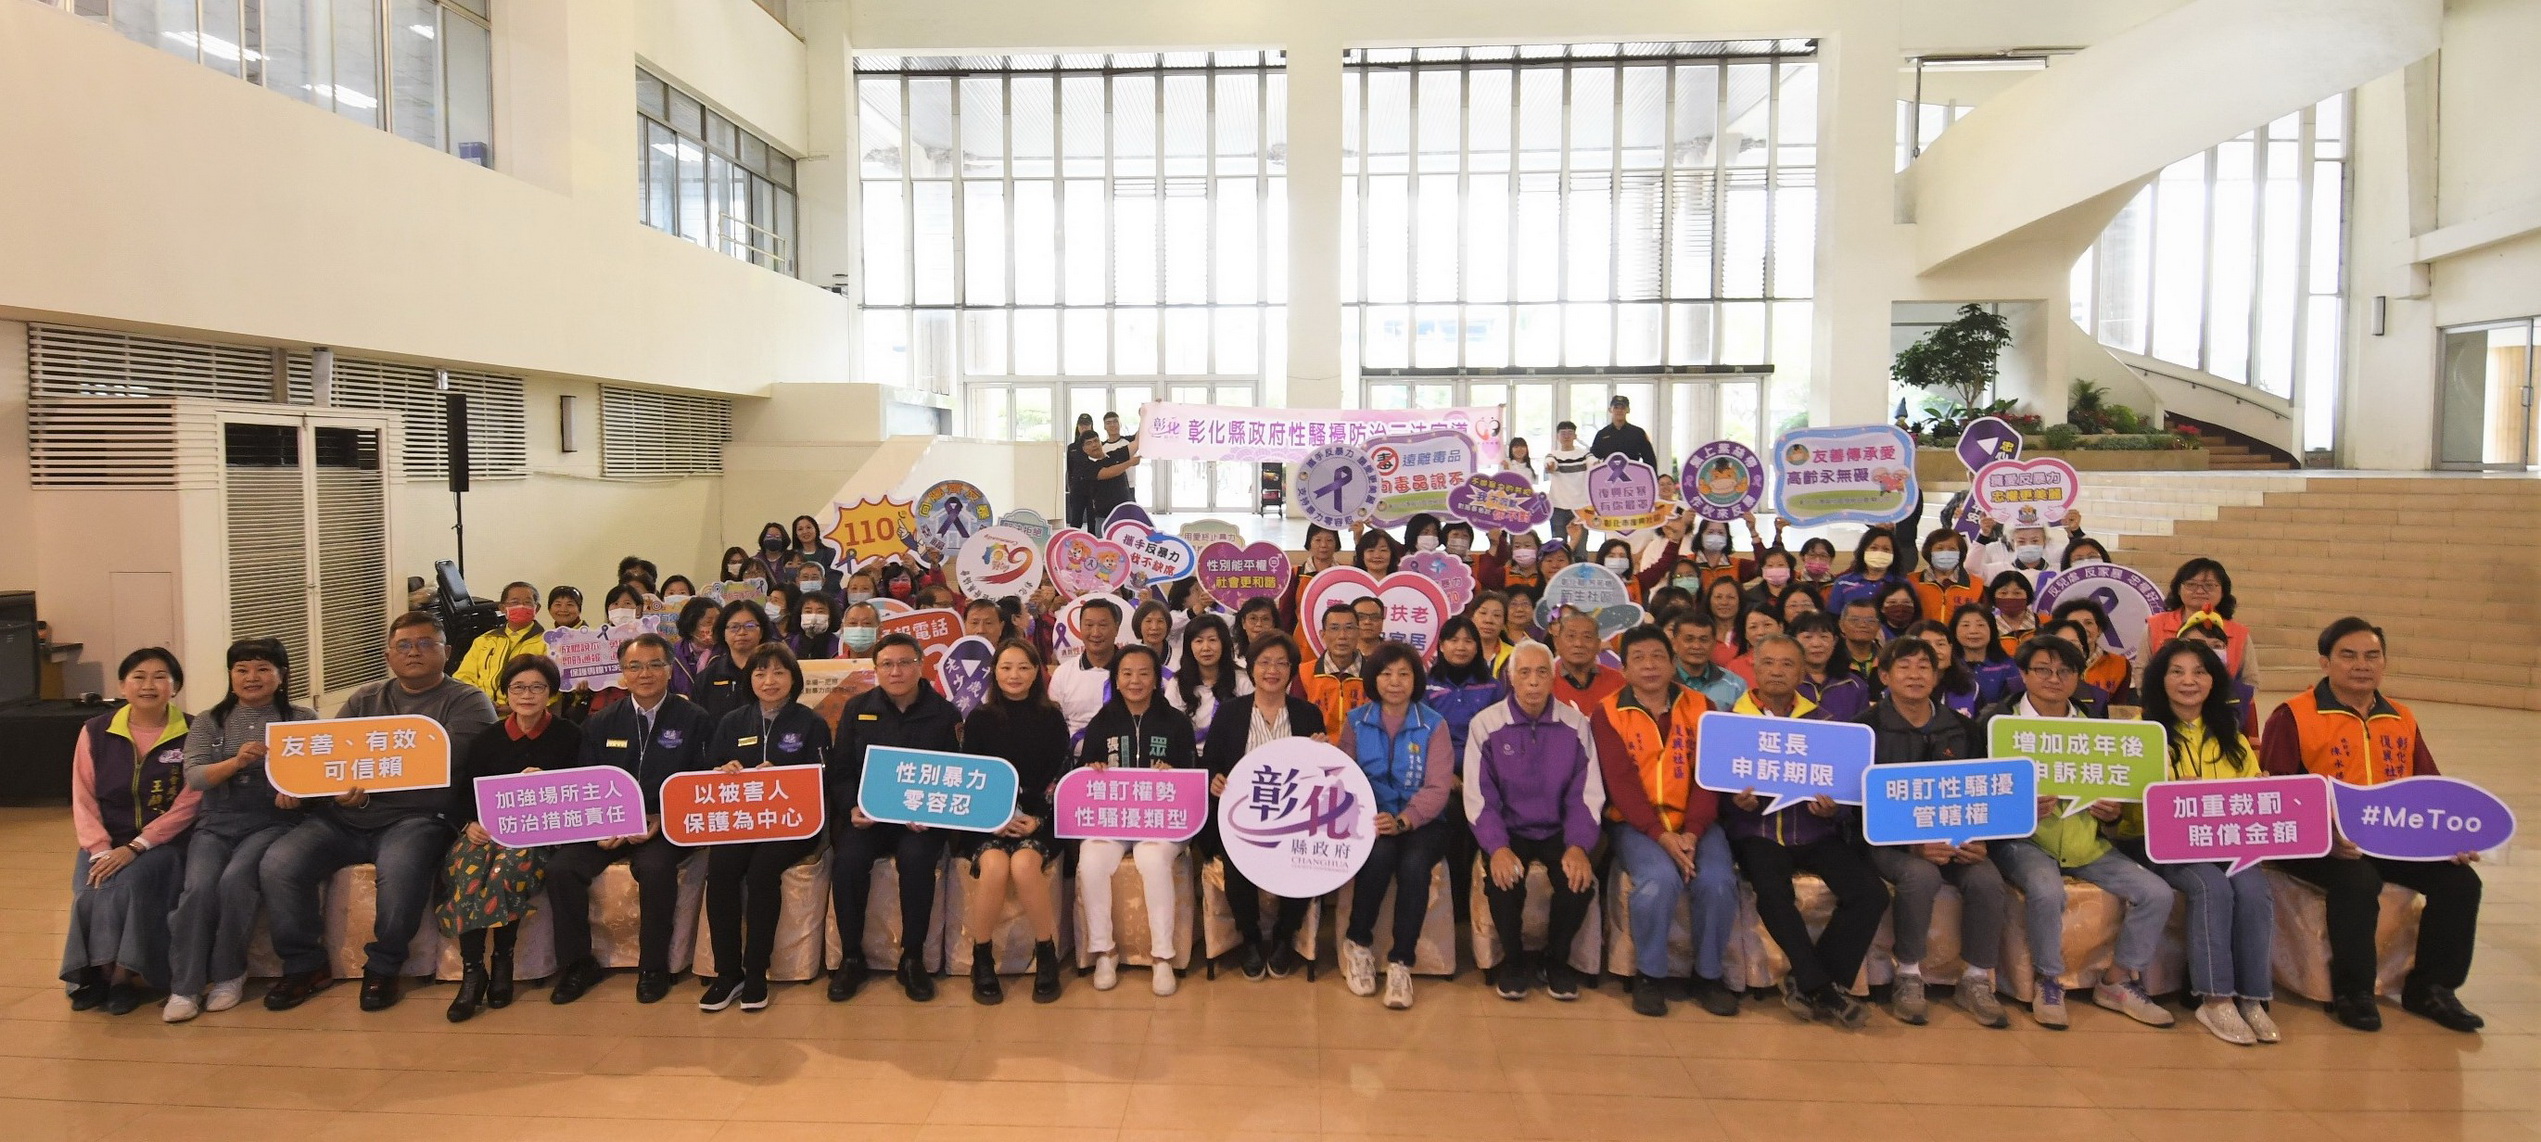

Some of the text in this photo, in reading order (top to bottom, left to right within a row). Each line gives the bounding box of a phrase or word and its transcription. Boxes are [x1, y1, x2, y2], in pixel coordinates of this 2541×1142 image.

[1402, 450, 1461, 467] 遠離毒品
[1812, 445, 1896, 463] 友善傳承愛
[845, 517, 895, 547] 110
[1185, 532, 1236, 541] 用愛終止暴力
[1122, 533, 1181, 563] 攜手反暴力
[1206, 559, 1268, 572] 性別能平權
[2085, 567, 2122, 578] 反家暴
[1215, 576, 1277, 589] 社會更和諧
[281, 728, 437, 758] 友善、有效、
[1758, 731, 1809, 757] 延長
[2012, 731, 2144, 758] 增加成年後
[324, 756, 403, 782] 可信賴
[896, 761, 988, 791] 性別暴力
[1731, 757, 1834, 787] 申訴期限
[495, 779, 623, 810] 加強場所主人
[694, 779, 790, 805] 以被害人
[1086, 779, 1177, 802] 增訂權勢
[1885, 772, 2014, 801] 明訂性騷擾
[903, 789, 972, 816] 零容忍
[1249, 765, 1352, 840] 彰化
[1913, 802, 1990, 828] 管轄權
[2173, 791, 2303, 819] 加重裁罰、
[498, 805, 626, 835] 防治措施責任
[683, 807, 804, 834] 保護為中心
[1075, 806, 1188, 830] 性騷擾類型
[2361, 804, 2483, 834] #MeToo
[2188, 820, 2299, 847] 賠償金額
[1291, 839, 1351, 859] 縣政府
